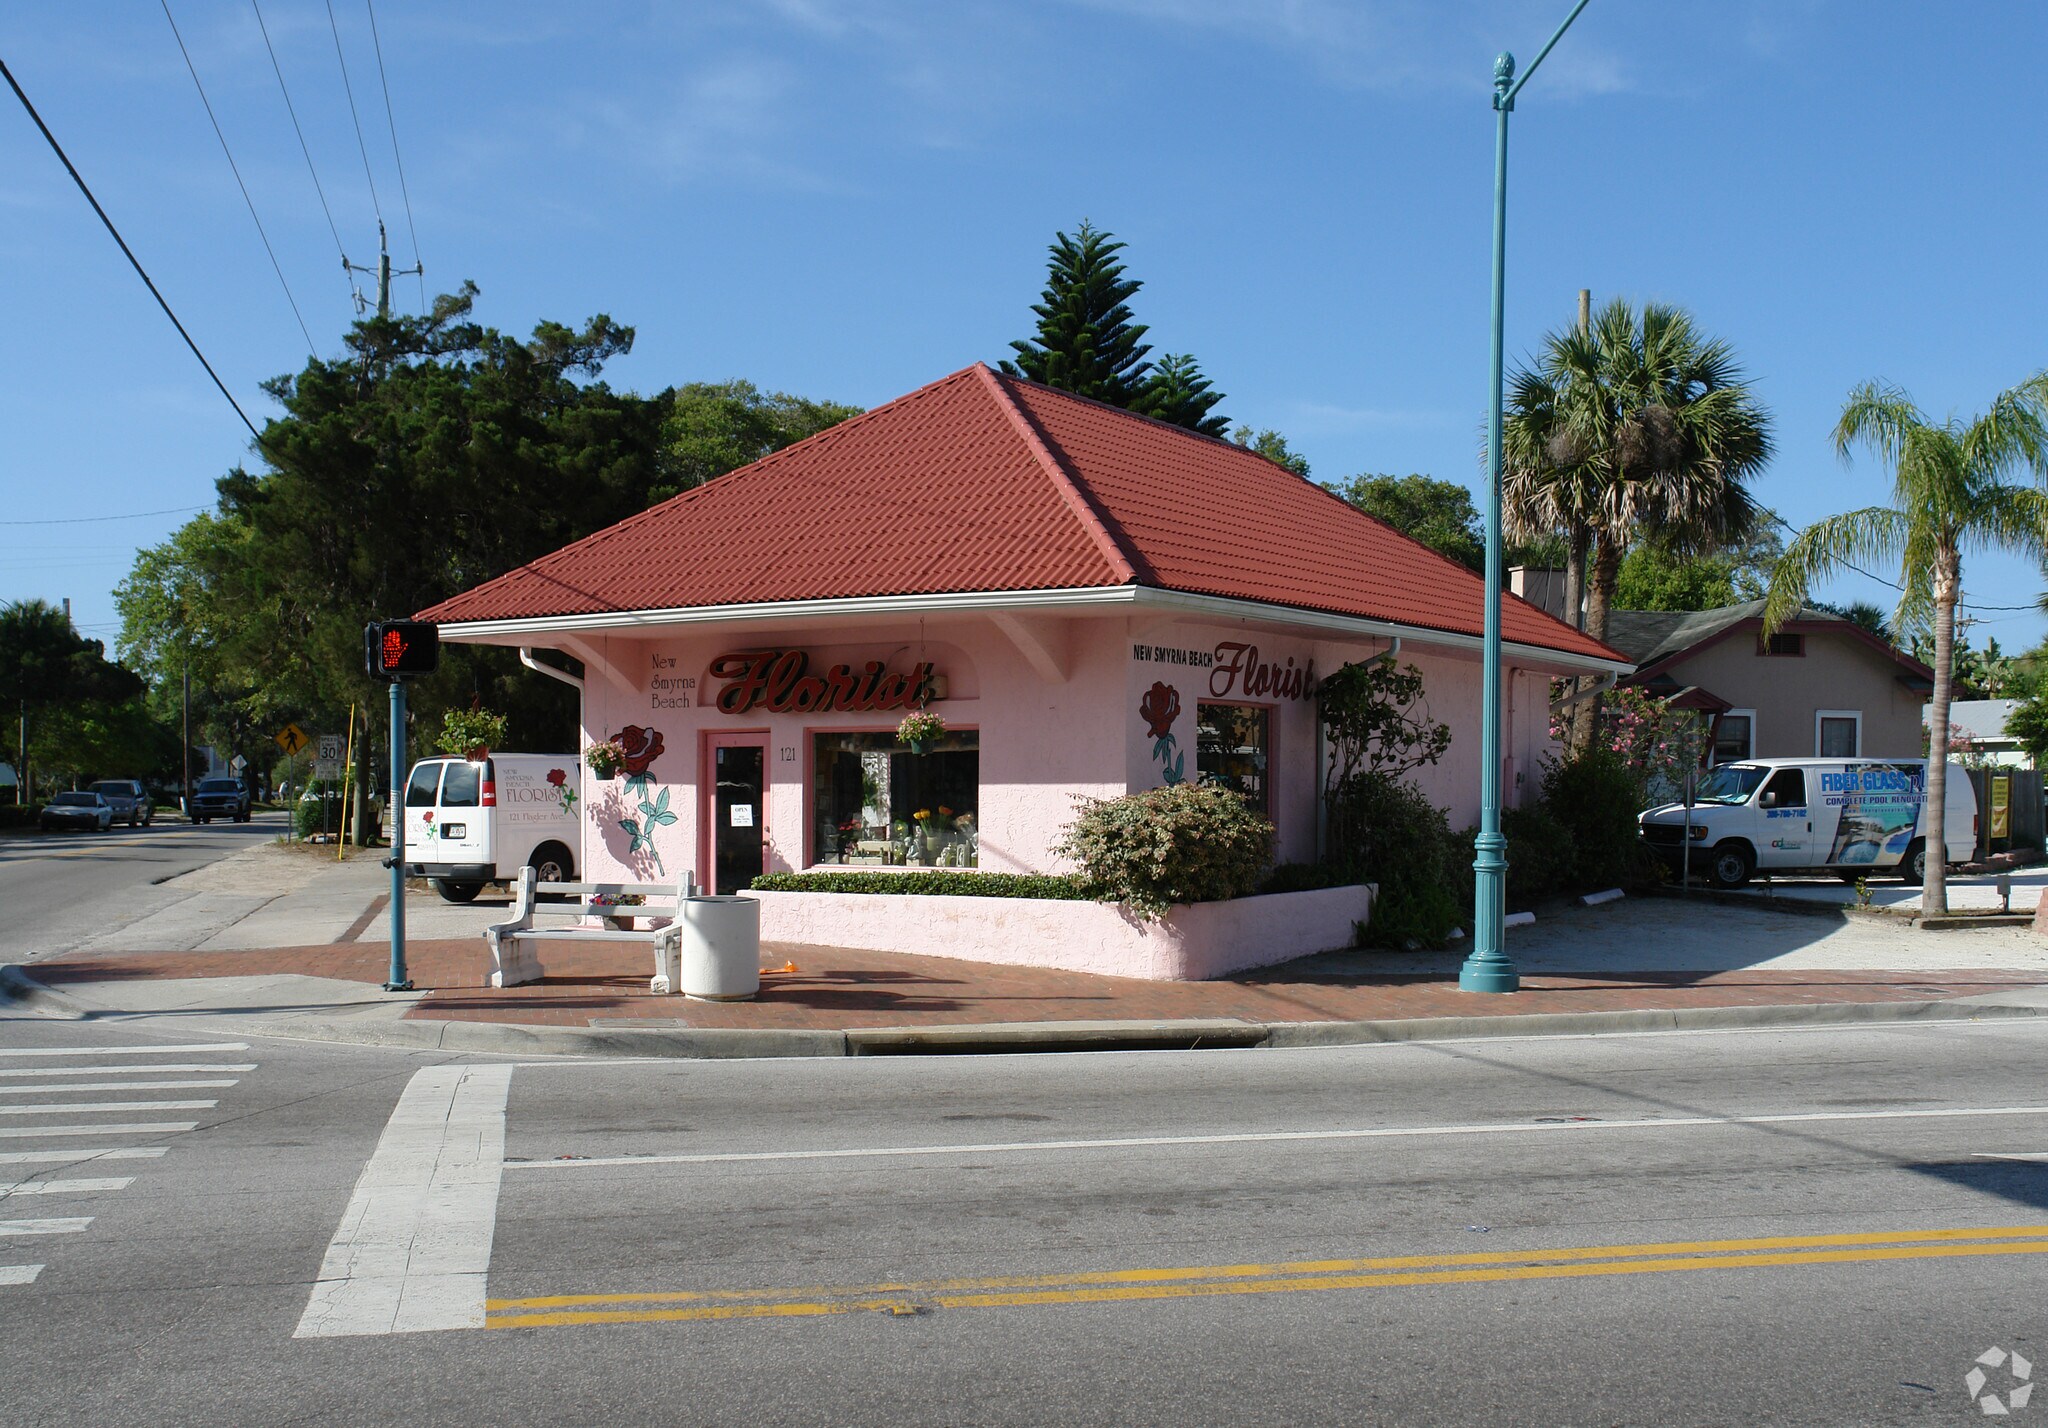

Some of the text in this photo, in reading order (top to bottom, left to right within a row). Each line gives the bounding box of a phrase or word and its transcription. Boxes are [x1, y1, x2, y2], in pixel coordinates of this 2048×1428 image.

[652, 653, 677, 669] New
[1133, 644, 1213, 668] NEW SMYRNA BEACH
[1209, 641, 1315, 701] Florist
[651, 674, 696, 694] Smyrna
[709, 650, 934, 715] Florist
[651, 692, 690, 709] Beach
[321, 747, 336, 759] 30
[780, 747, 796, 761] 121
[506, 788, 563, 802] FLORIST
[1826, 795, 1928, 806] COMPLETE POOL RENOVATI
[509, 813, 520, 821] 121
[523, 812, 547, 823] Flagler
